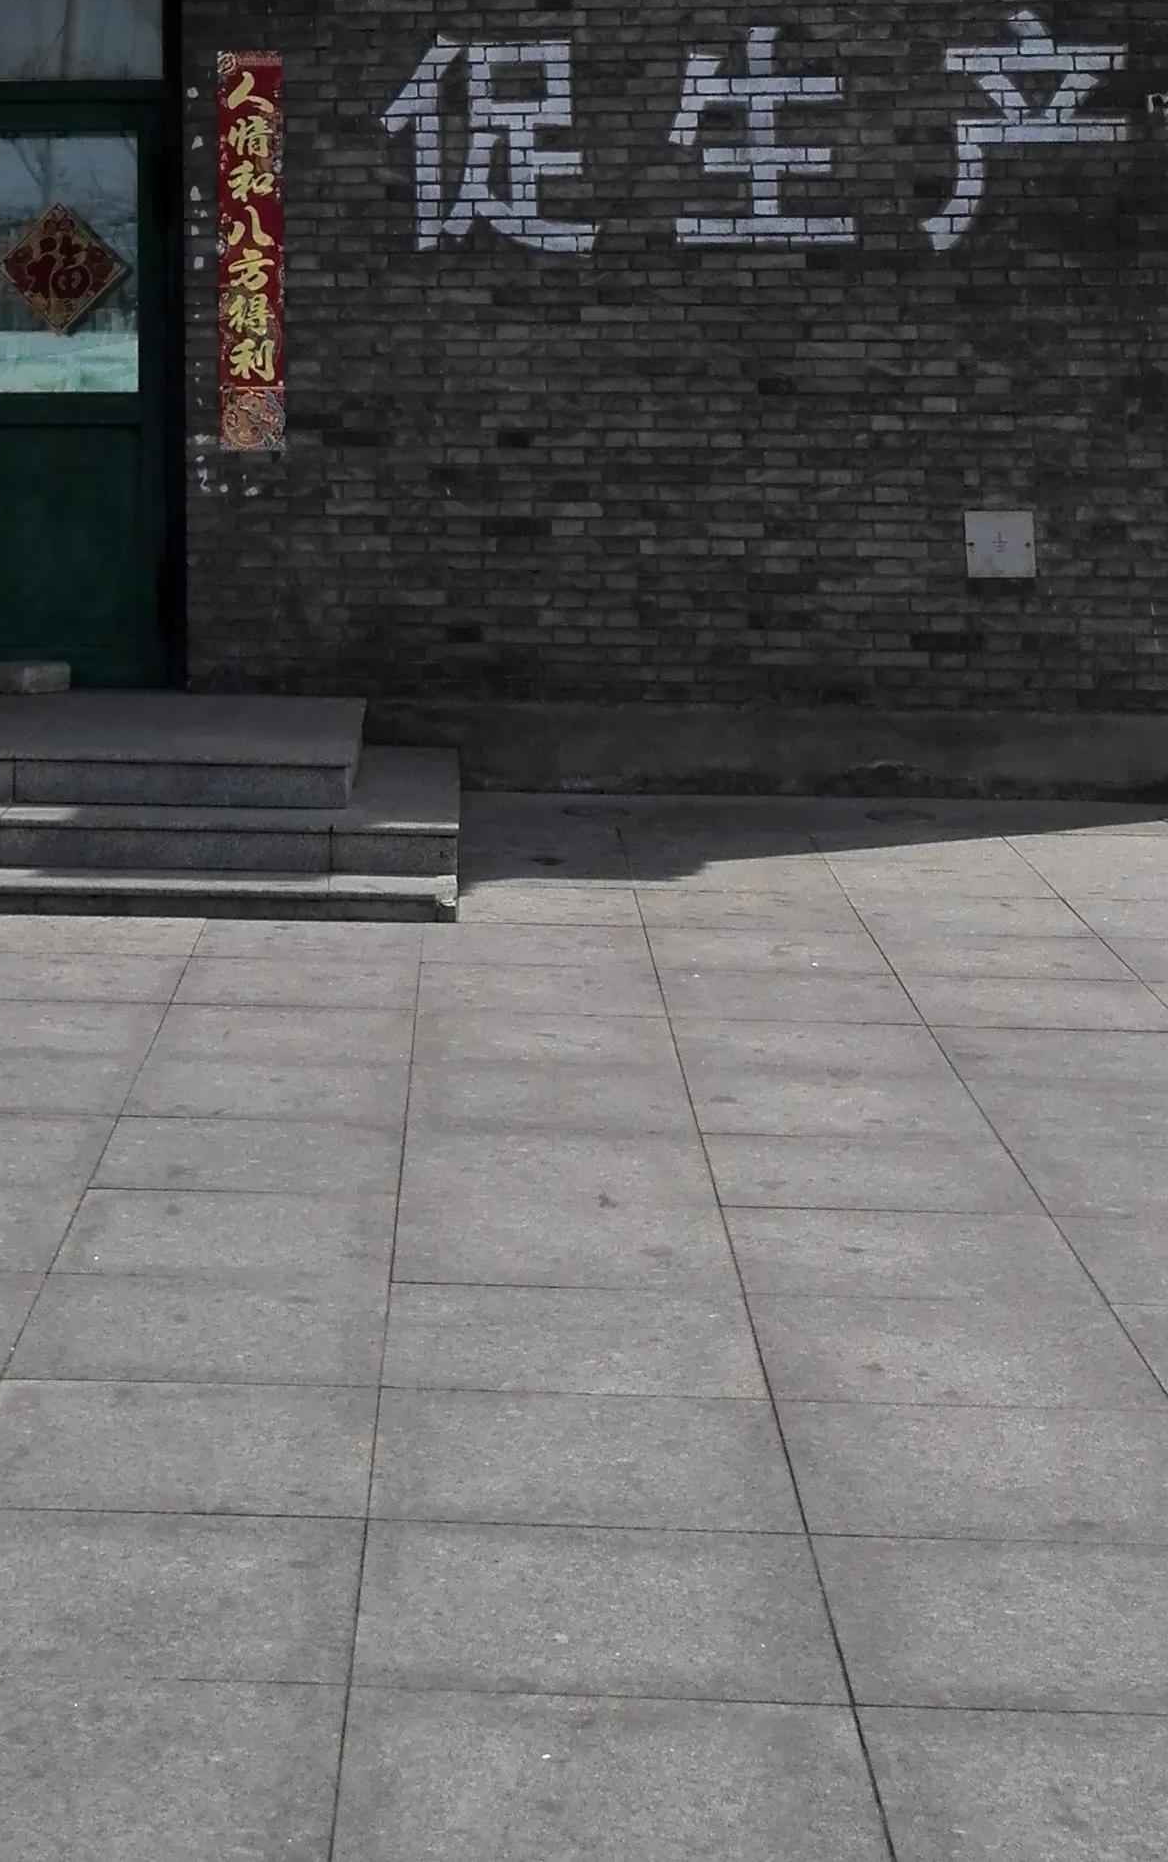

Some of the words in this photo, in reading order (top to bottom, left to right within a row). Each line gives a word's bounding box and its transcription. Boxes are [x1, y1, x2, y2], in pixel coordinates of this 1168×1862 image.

[227, 71, 275, 382] 人情和八方得利
[379, 10, 1129, 255] 促生产
[24, 234, 93, 300] 福
